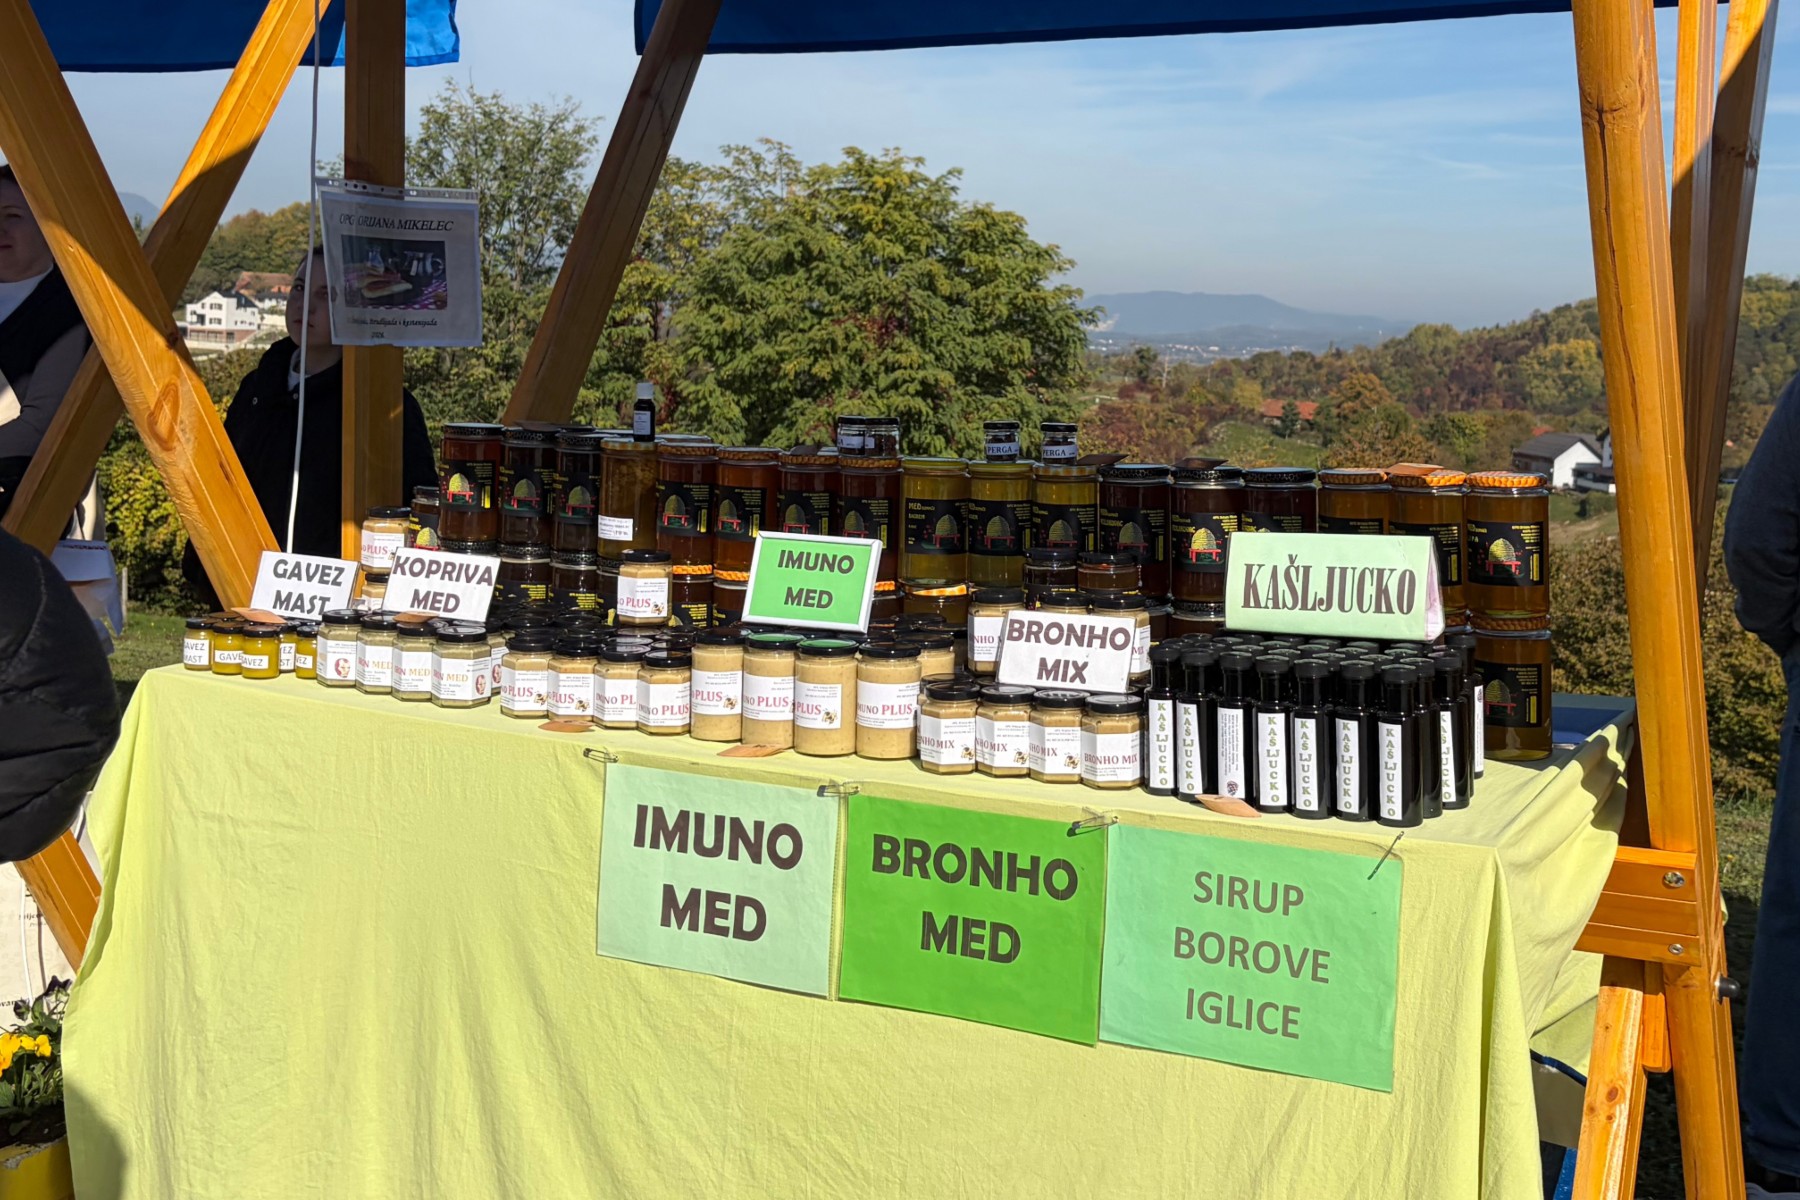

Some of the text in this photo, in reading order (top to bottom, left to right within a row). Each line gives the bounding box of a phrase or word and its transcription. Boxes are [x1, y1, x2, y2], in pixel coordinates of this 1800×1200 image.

[397, 219, 455, 232] MIKELEC
[367, 545, 389, 556] PLUS
[778, 549, 855, 575] IMUNO
[272, 558, 346, 587] GAVEZ
[392, 555, 495, 587] KOPRIVA
[784, 586, 834, 610] MED
[1241, 554, 1417, 616] KAŠLJUCKO
[272, 589, 332, 614] MAST
[410, 588, 461, 614] MED
[626, 596, 652, 609] PLUS
[1006, 619, 1131, 652] BRONHO
[446, 673, 469, 683] MED
[1036, 657, 1089, 685] MIX
[695, 690, 724, 703] PLUS
[757, 696, 790, 708] PLUS
[796, 702, 822, 715] PLUS
[881, 703, 914, 716] PLUS
[661, 704, 690, 718] PLUS
[936, 739, 956, 750] MIX
[990, 742, 1008, 753] MIX
[634, 803, 804, 871] IMUNO
[872, 833, 1079, 902] BRONHO
[1193, 871, 1305, 917] SIRUP
[660, 884, 768, 942] MED
[921, 910, 1022, 965] MED
[1174, 926, 1331, 985] BOROVE
[1186, 988, 1305, 1041] IGLICE
